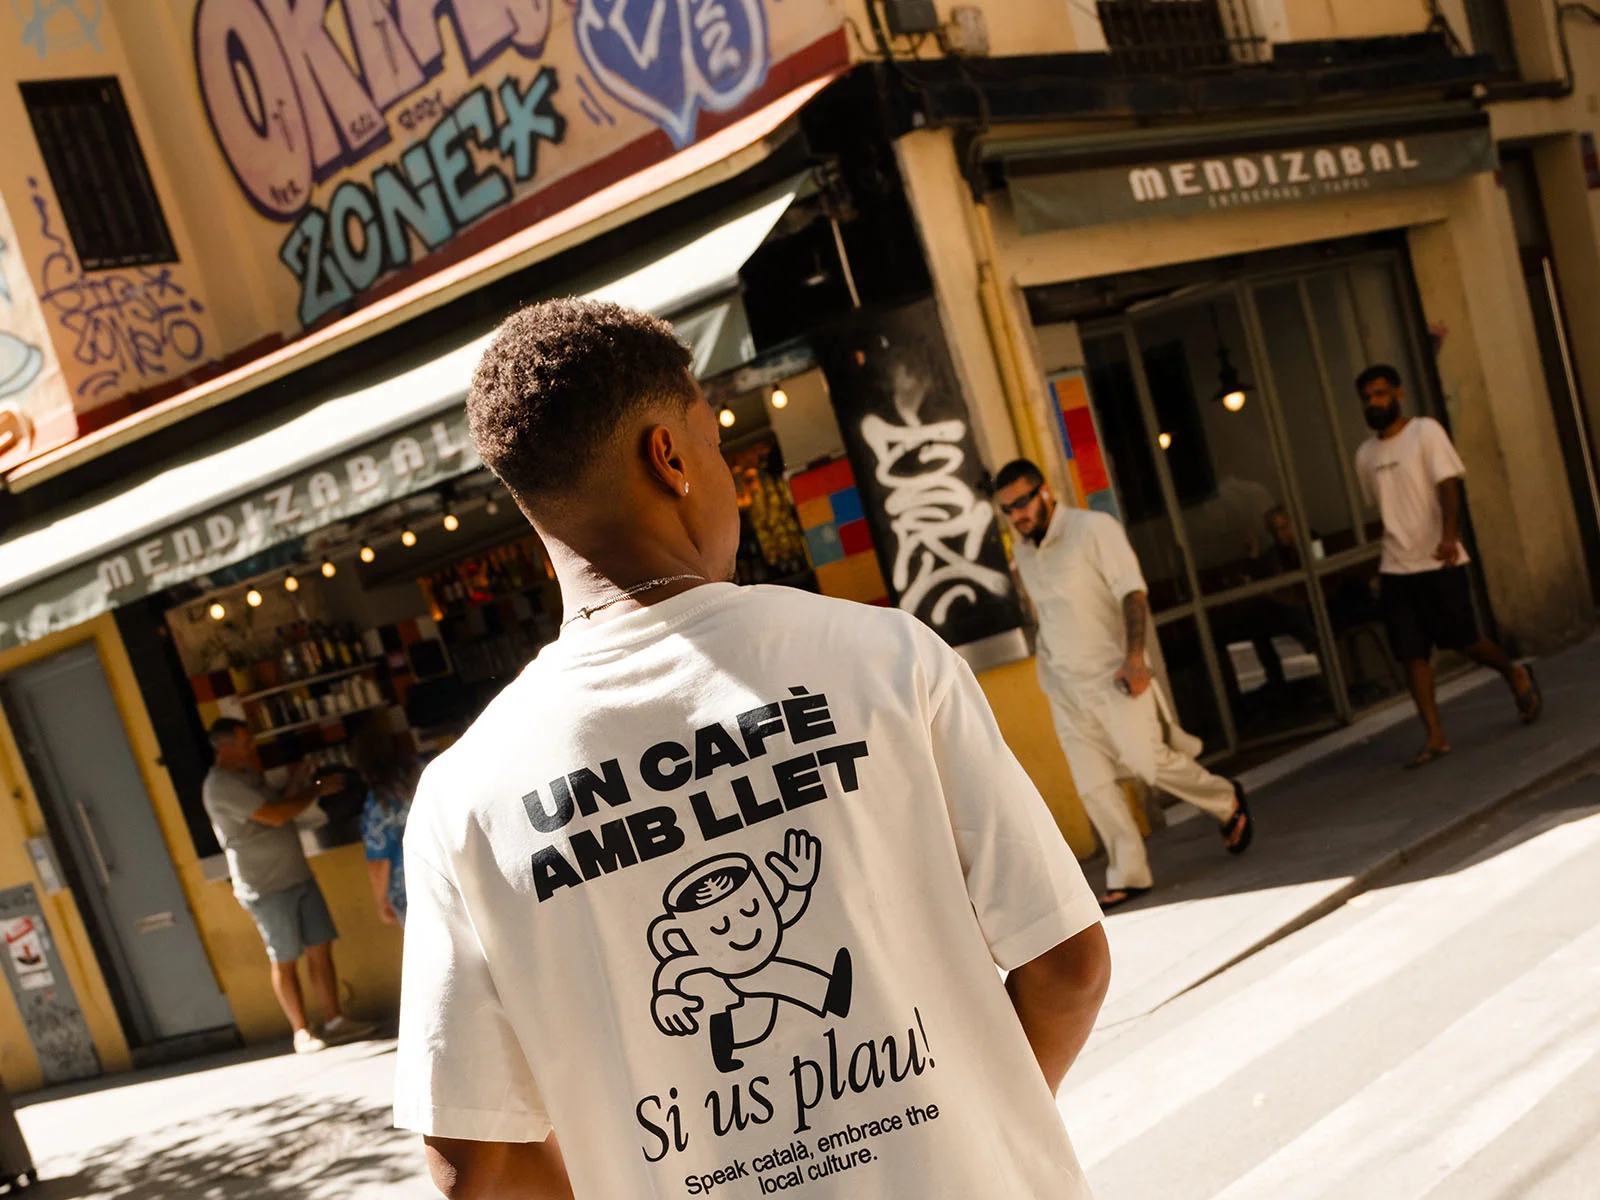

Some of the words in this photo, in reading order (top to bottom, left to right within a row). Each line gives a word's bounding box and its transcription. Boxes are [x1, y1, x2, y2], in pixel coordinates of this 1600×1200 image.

[1128, 139, 1420, 202] MENDIZABAL
[97, 421, 470, 594] MENDIZABAL
[522, 758, 632, 834] UN
[639, 685, 837, 792] CAFÈ
[530, 806, 686, 903] AMB
[689, 740, 869, 842] LLET
[636, 1087, 689, 1163] Si
[704, 1075, 774, 1137] us
[789, 1006, 936, 1135] plau!
[684, 1159, 750, 1196] Speak
[751, 1141, 815, 1174] català,
[816, 1112, 903, 1153] embrace
[905, 1103, 940, 1127] the
[758, 1165, 805, 1196] local
[807, 1147, 879, 1182] culture.
